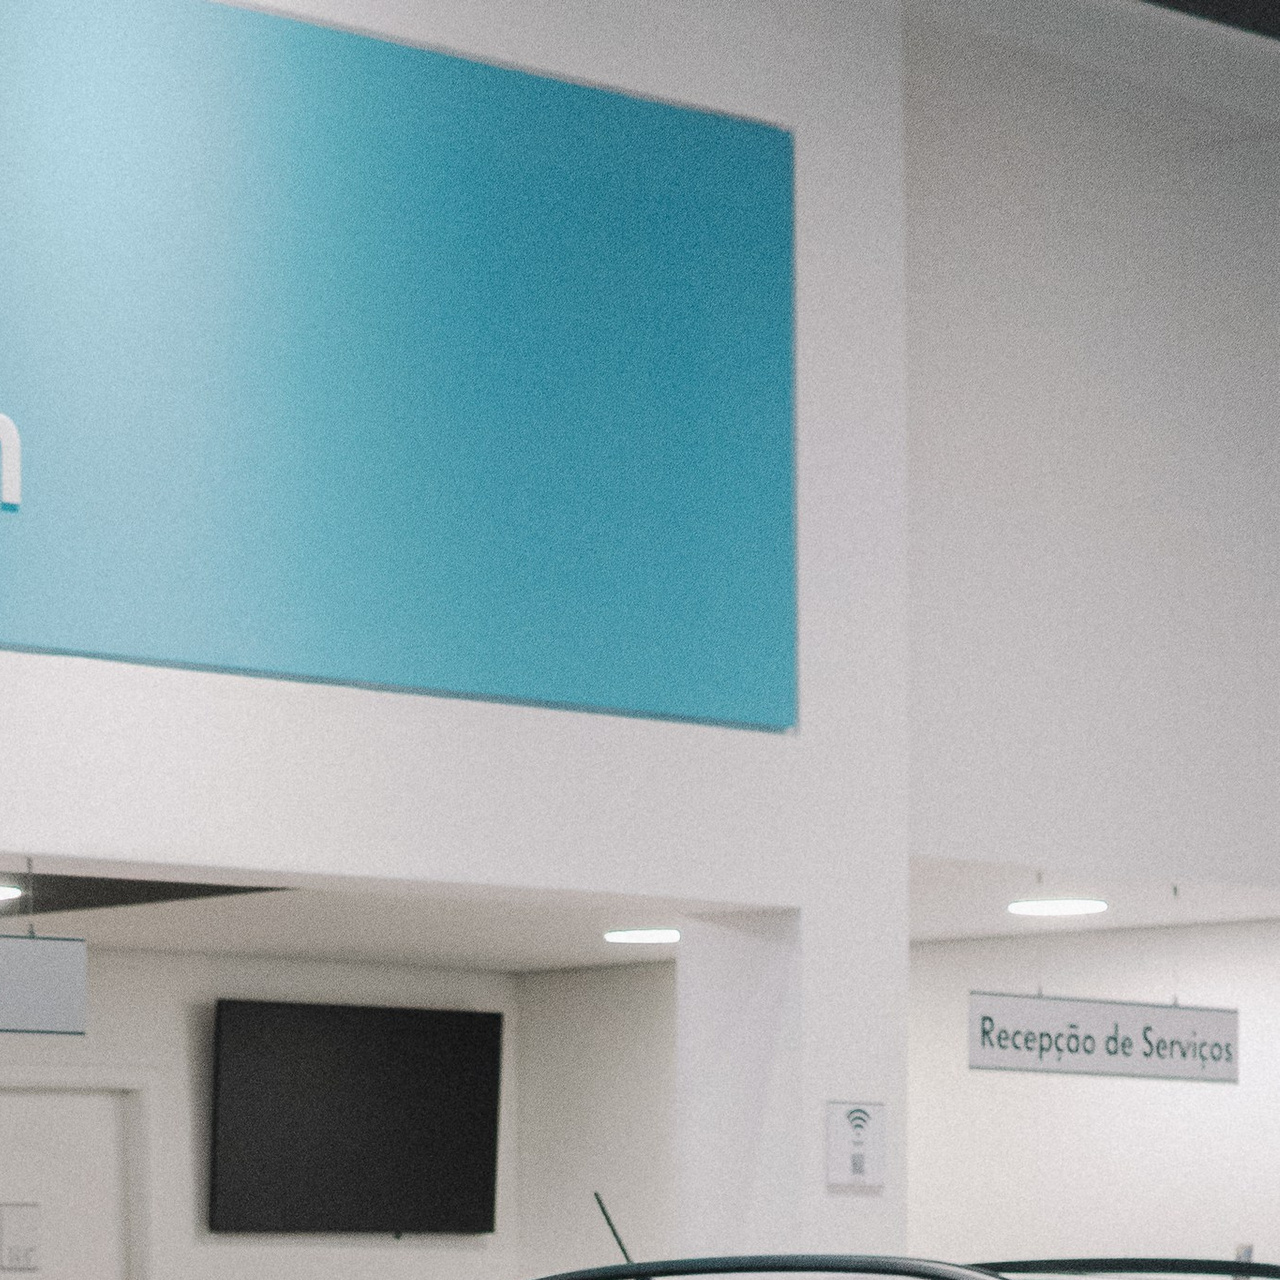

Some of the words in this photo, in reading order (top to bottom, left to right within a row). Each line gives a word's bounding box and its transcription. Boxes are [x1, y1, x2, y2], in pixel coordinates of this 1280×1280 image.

[980, 1015, 1096, 1061] Recepção
[1104, 1023, 1133, 1056] de
[1142, 1025, 1233, 1069] Serviços
